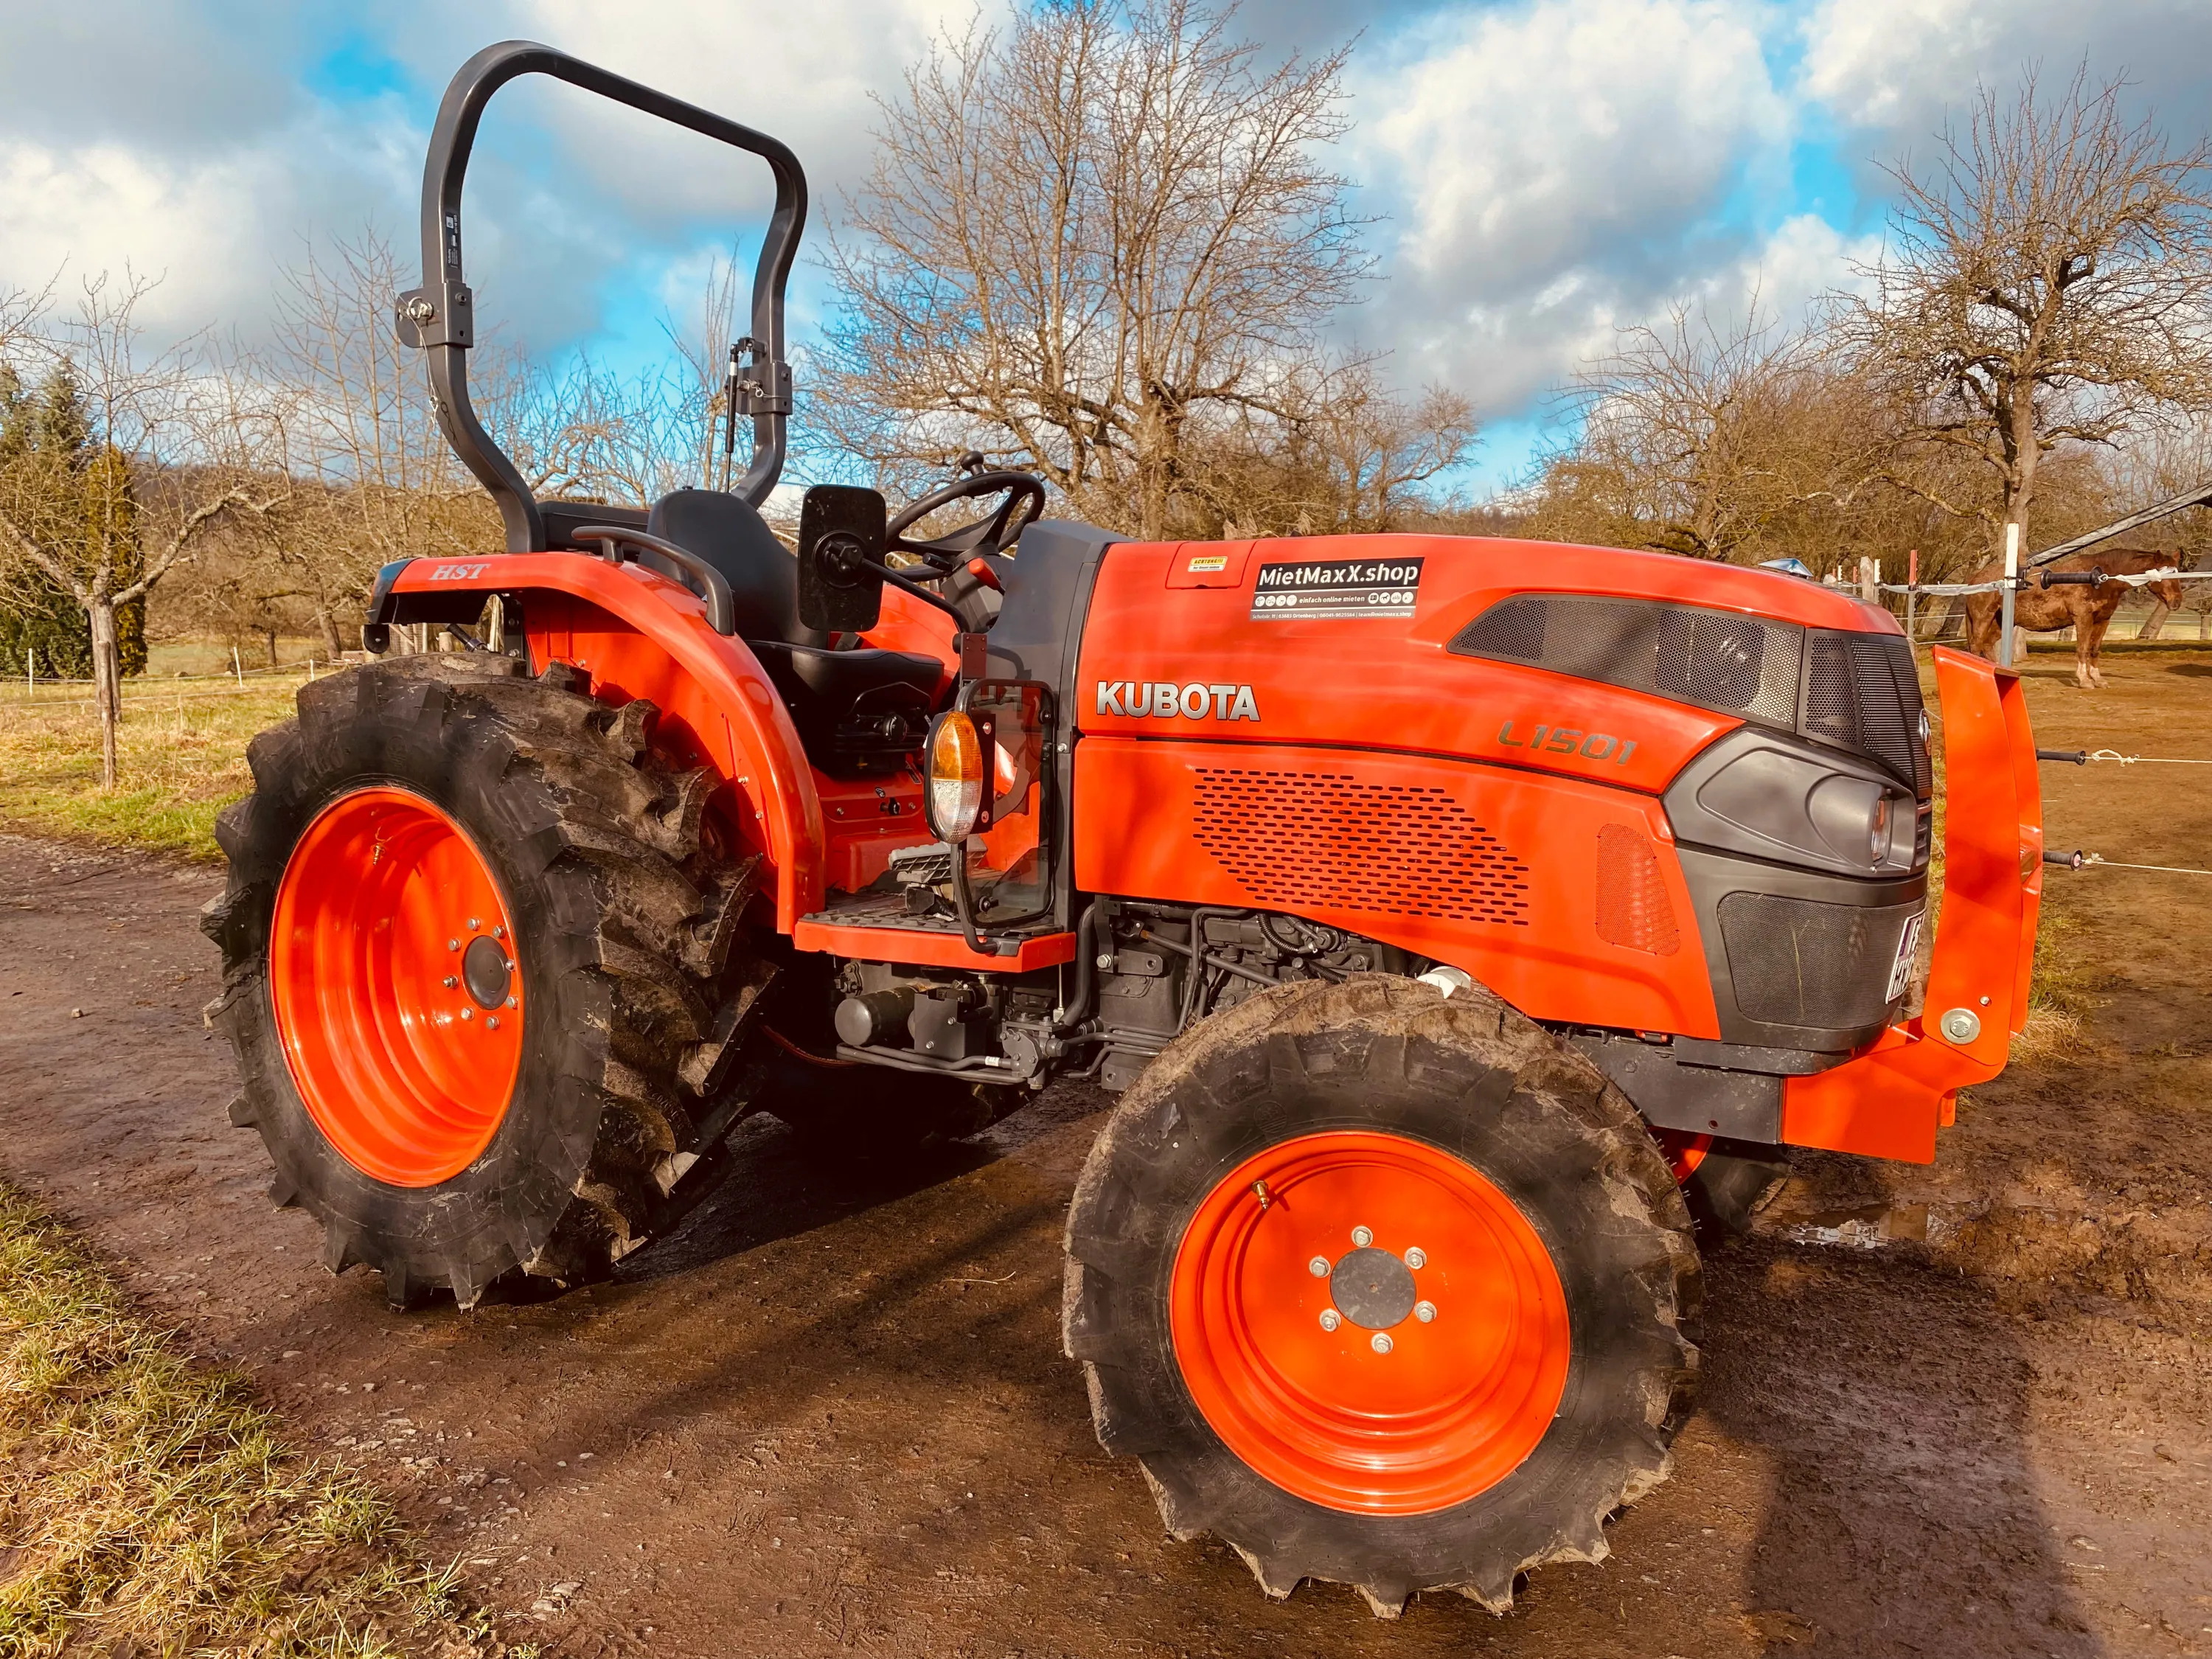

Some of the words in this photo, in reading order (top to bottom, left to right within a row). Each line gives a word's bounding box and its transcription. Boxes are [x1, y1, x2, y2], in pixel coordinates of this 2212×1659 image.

[428, 563, 492, 580] HST
[1259, 563, 1418, 585] MietMaxX.shop
[1096, 681, 1262, 722] KUBOTA
[1498, 721, 1638, 765] L1501
